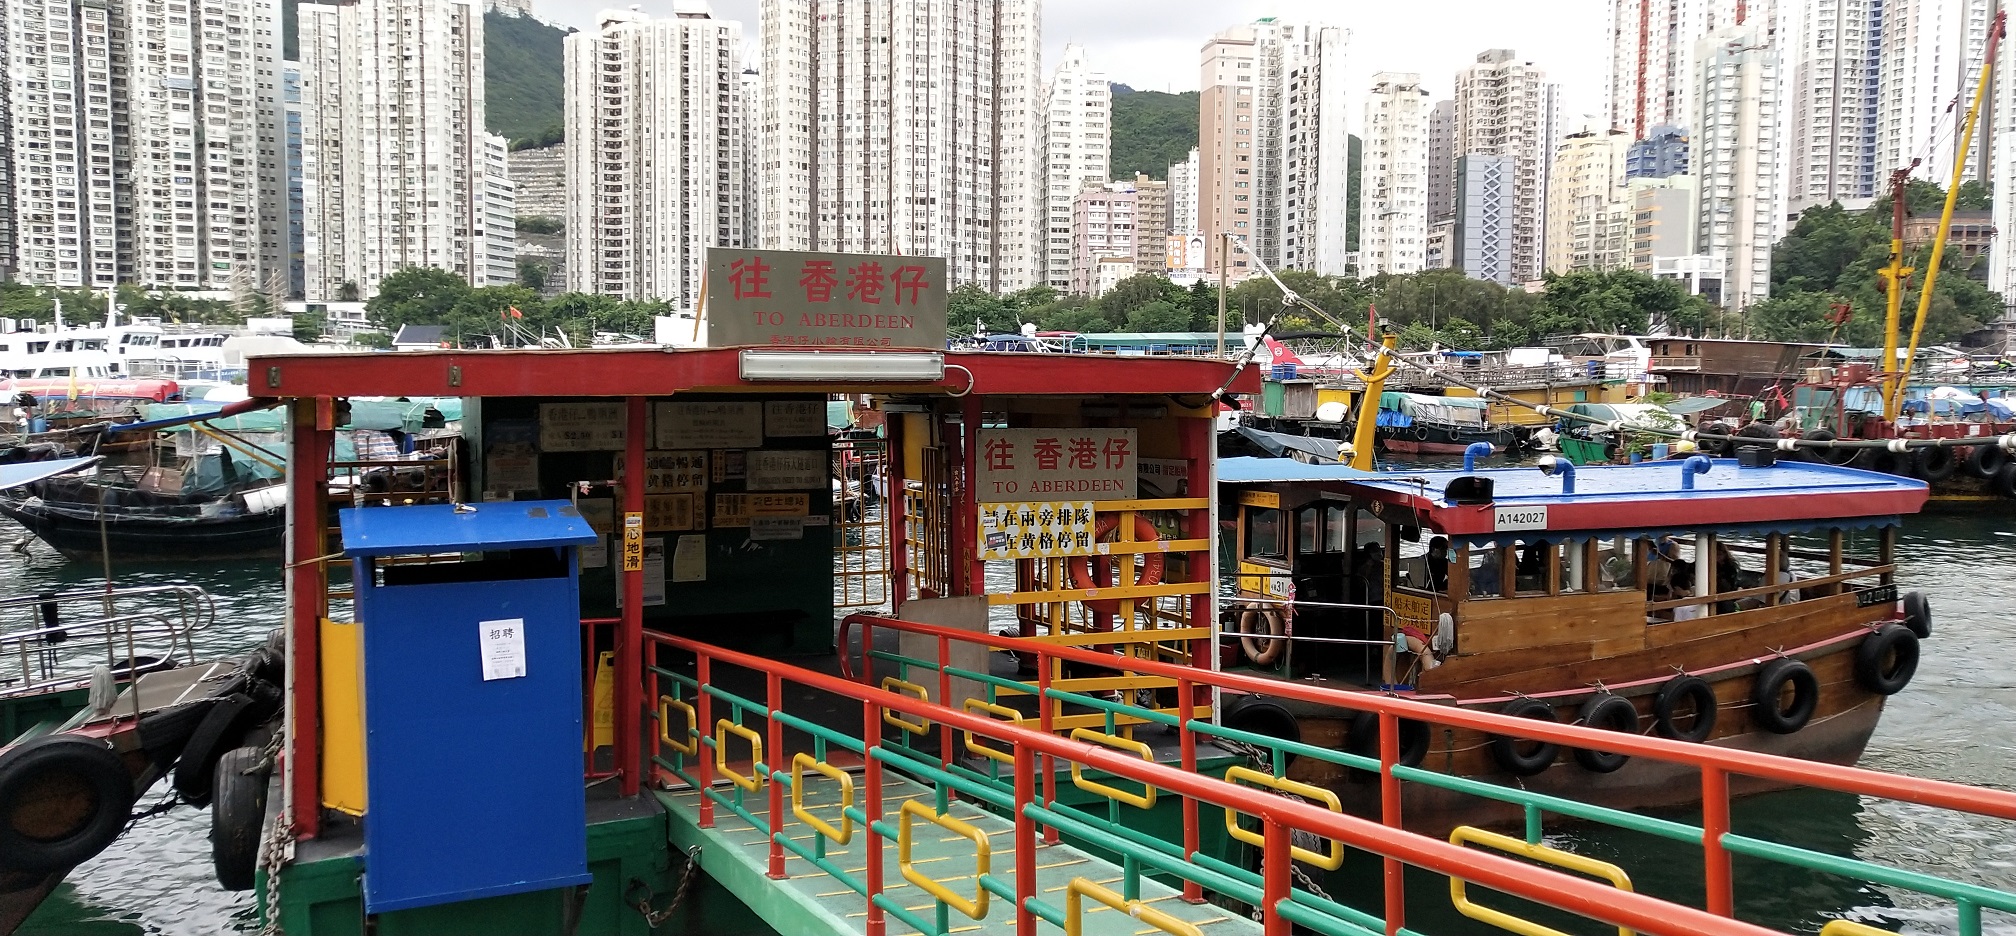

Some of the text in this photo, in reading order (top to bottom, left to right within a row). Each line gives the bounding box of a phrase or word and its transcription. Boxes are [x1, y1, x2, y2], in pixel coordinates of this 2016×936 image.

[728, 256, 929, 306] 往 香港仔
[753, 311, 914, 329] TO ABERDEEN
[984, 437, 1130, 471] 往 香港仔
[993, 479, 1124, 493] TO ABERDEEN
[1498, 513, 1545, 525] A142027
[489, 628, 514, 640] 招聘
